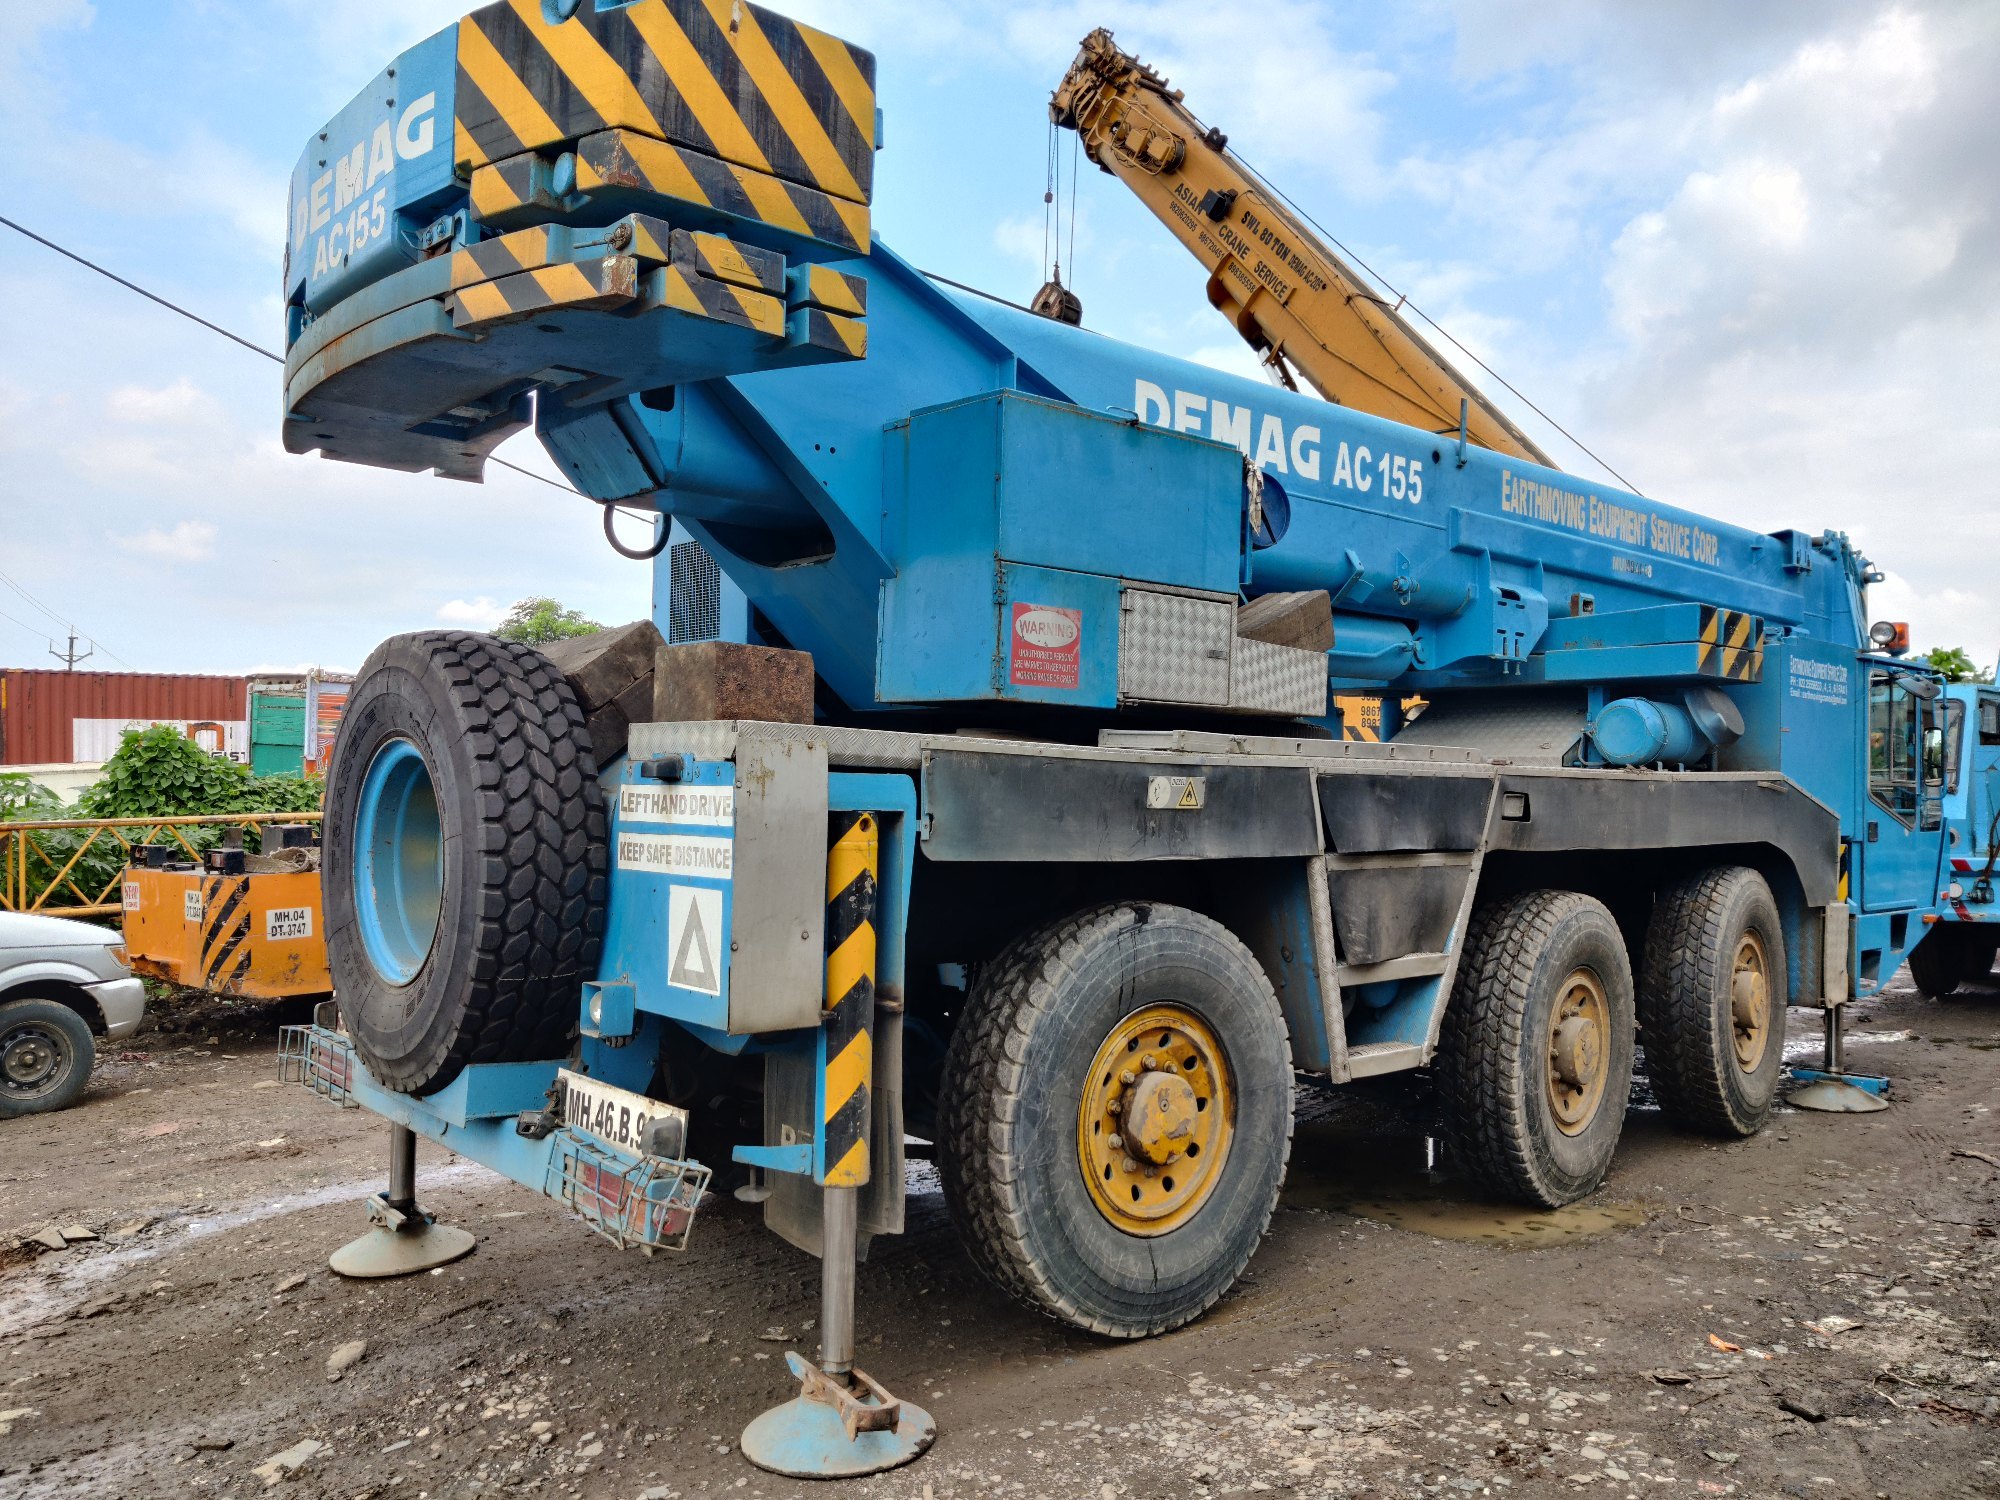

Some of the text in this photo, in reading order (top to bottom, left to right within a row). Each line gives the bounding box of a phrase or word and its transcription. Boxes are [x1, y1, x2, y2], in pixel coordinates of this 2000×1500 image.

[295, 91, 436, 253] DEMAG
[312, 187, 386, 281] AC 155
[1174, 183, 1288, 299] ASIAN CRANE SERVICE
[1199, 231, 1225, 260] 986720451
[1241, 211, 1261, 235] SWL
[1260, 227, 1274, 246] 80
[1271, 237, 1291, 261] TON
[1287, 254, 1309, 277] DEMAG
[1228, 262, 1256, 293] 898385558
[1135, 378, 1423, 505] DEMAG AC 155
[1502, 469, 1586, 531] EARTHMOVING
[1589, 495, 1648, 547] EQUIPMENT
[1650, 512, 1690, 559] SERVICE
[1020, 619, 1074, 639] WARNING
[621, 791, 733, 817] LEFT HAND DRIVE
[620, 842, 731, 869] KEEP SAFE DISTANCE
[271, 923, 306, 937] DT.3747
[274, 910, 304, 922] MH.04
[568, 1087, 655, 1151] MH.46.B.9
